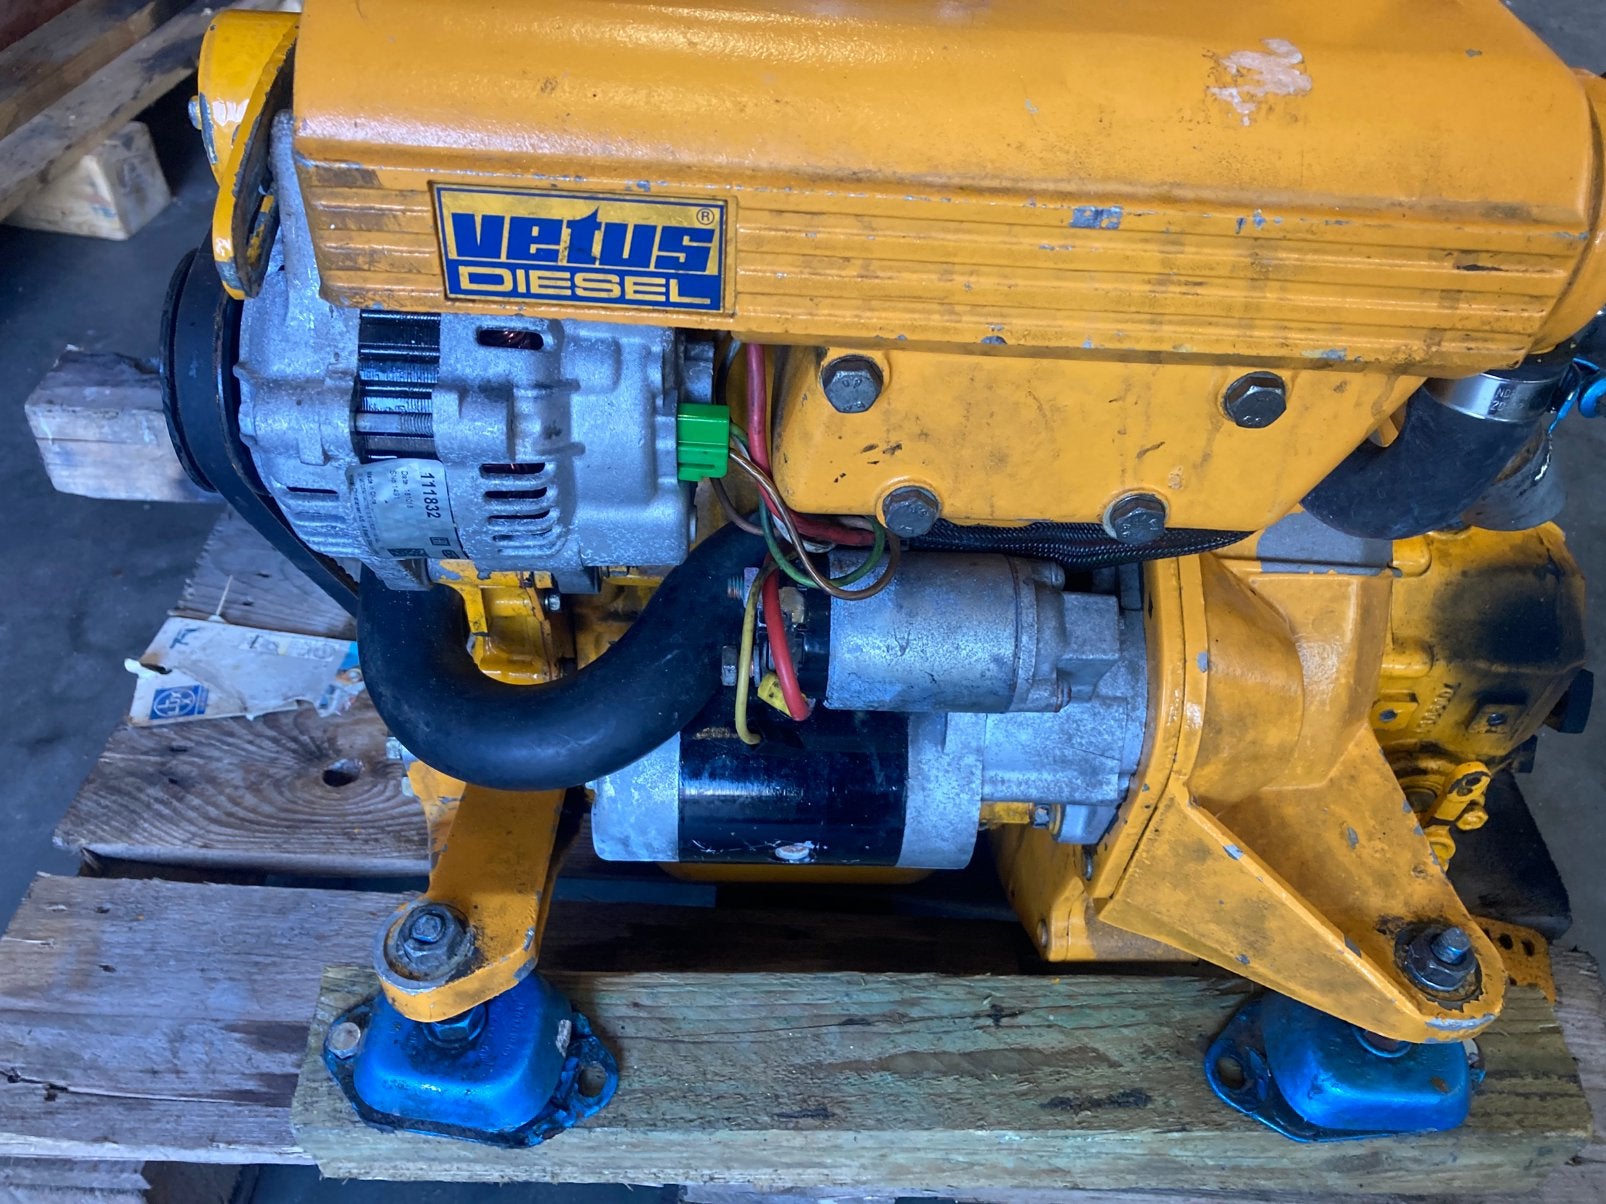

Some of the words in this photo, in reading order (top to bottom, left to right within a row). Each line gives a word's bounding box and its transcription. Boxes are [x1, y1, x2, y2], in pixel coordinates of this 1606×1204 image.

[451, 206, 715, 273] vetus
[458, 265, 711, 305] DIESEL
[420, 472, 442, 519] 111832
